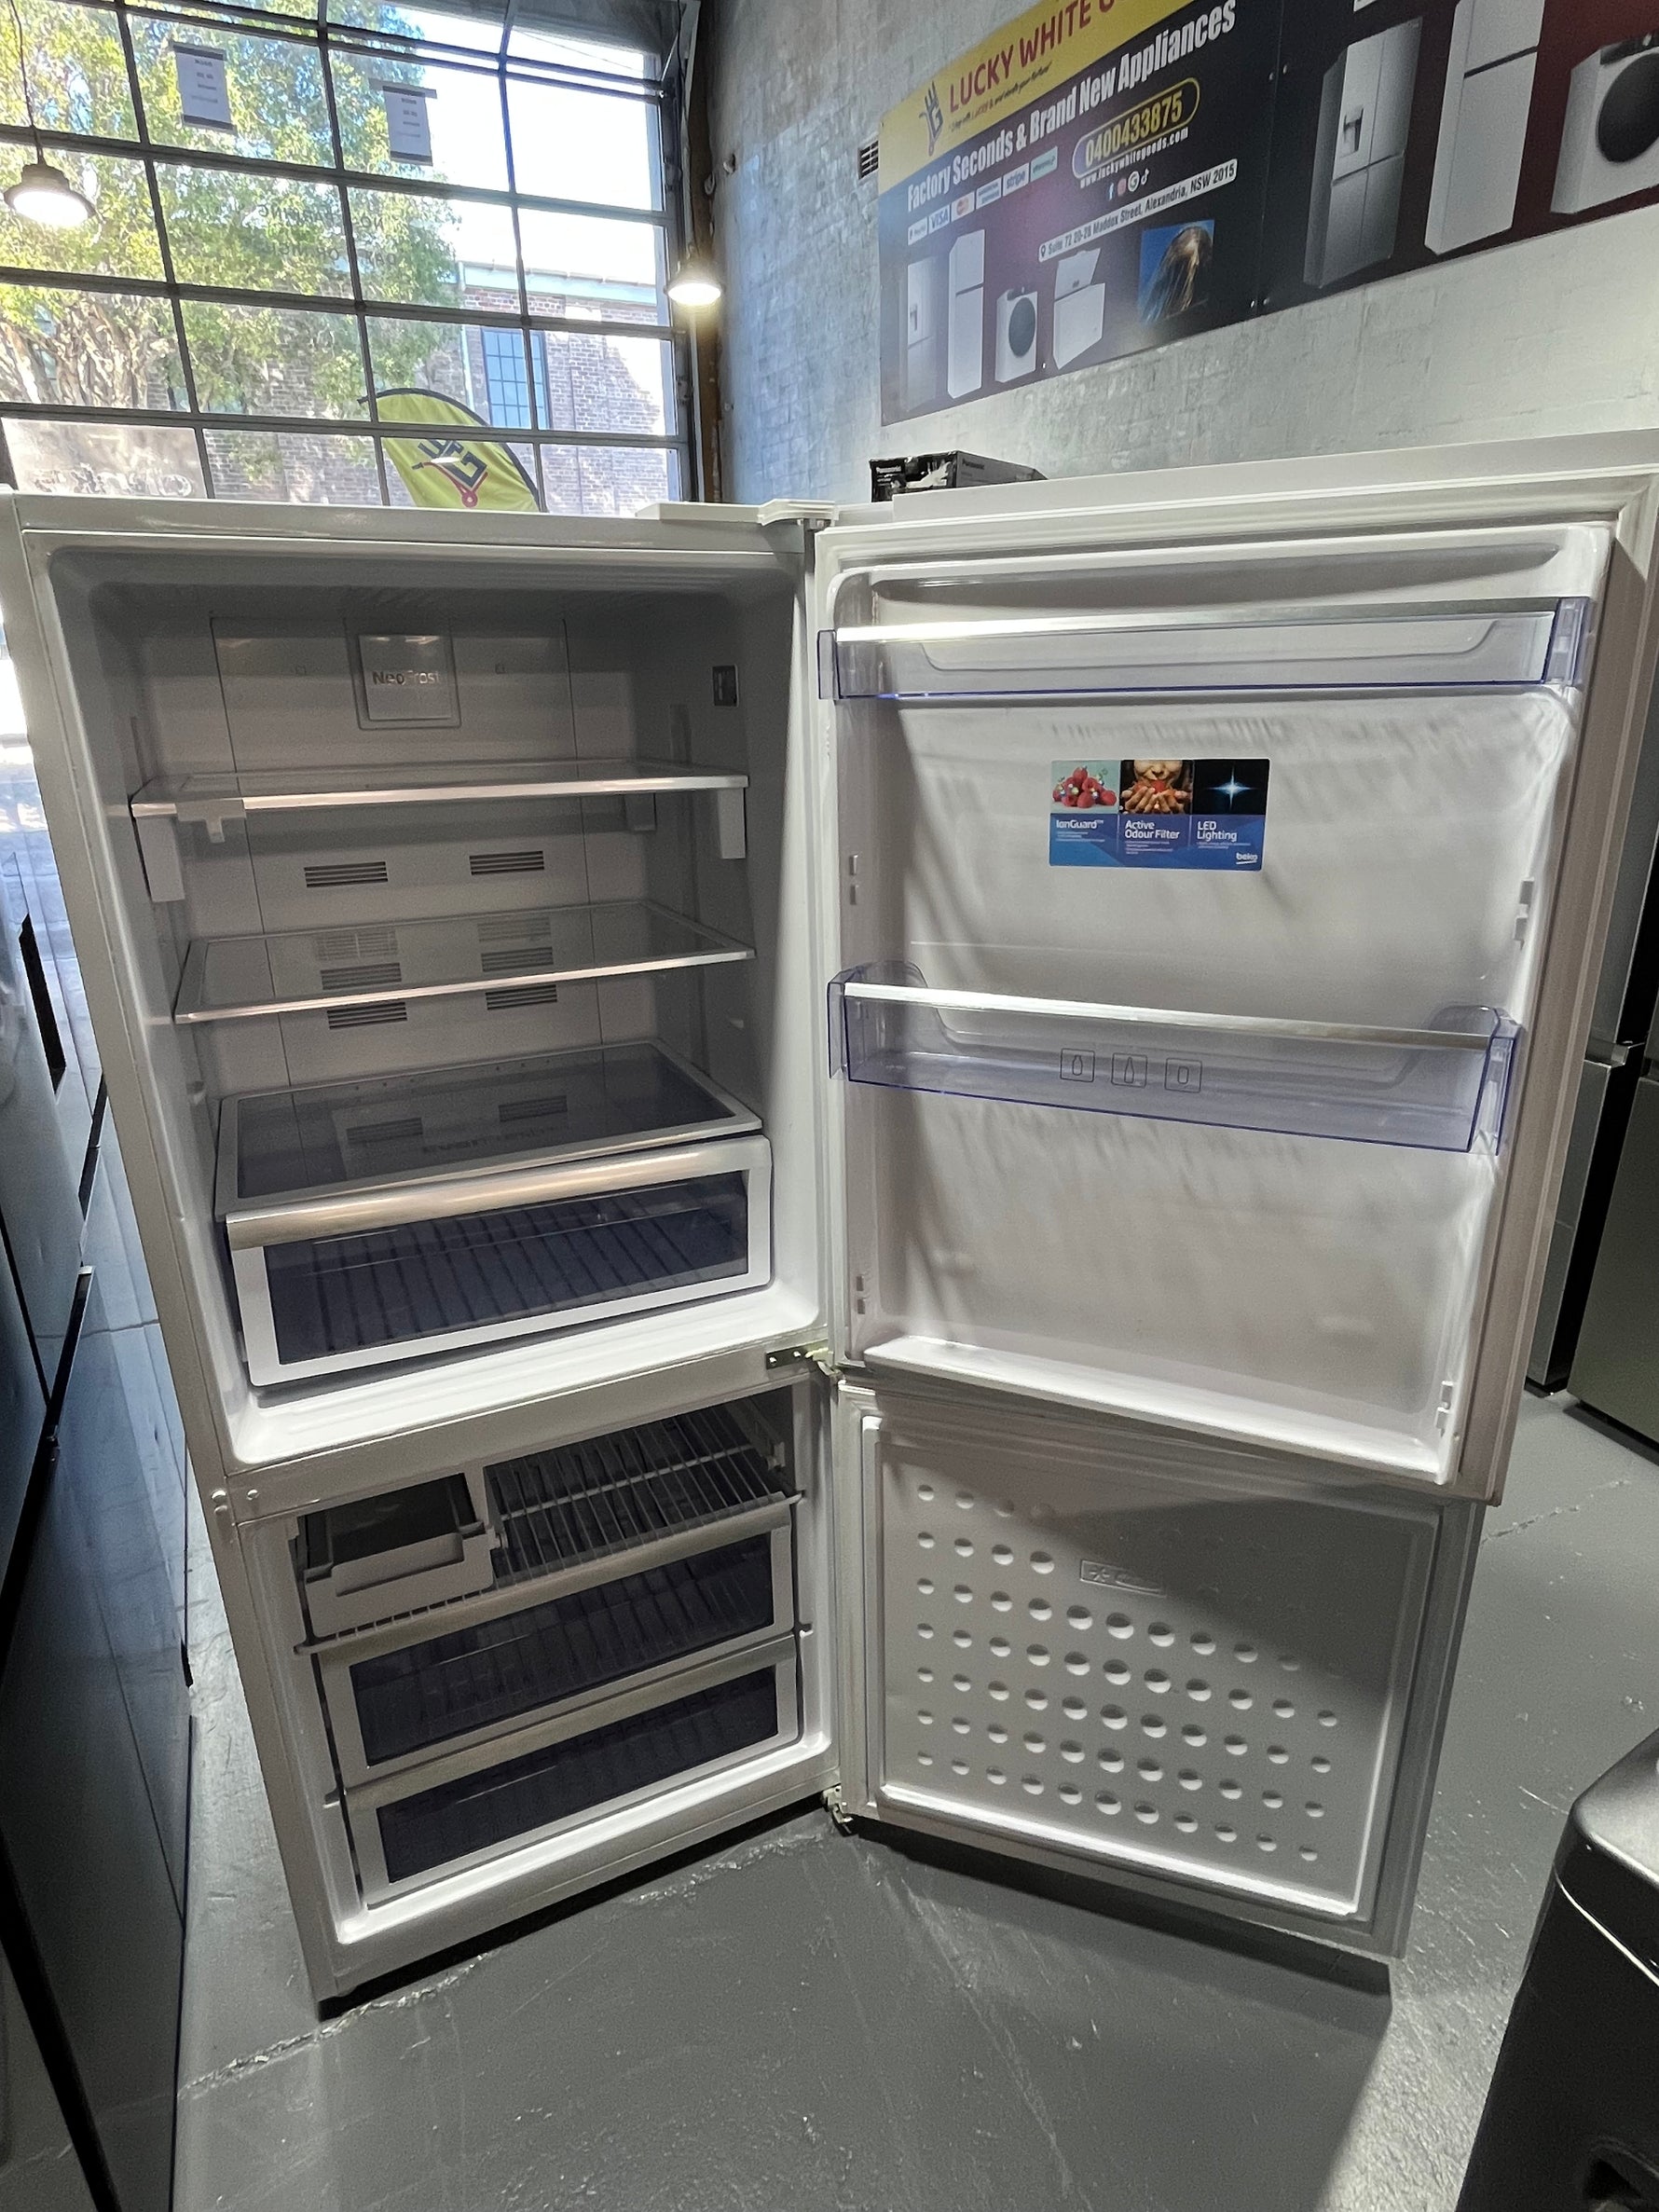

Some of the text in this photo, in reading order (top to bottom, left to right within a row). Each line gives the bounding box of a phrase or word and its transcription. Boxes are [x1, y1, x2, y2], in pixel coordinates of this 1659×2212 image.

[950, 44, 1014, 113] LUCKY
[1019, 0, 1091, 68] WHITE
[908, 165, 952, 213] Factory
[953, 129, 1013, 185] Seconds
[1016, 122, 1027, 150] &
[1030, 86, 1076, 144] Brand
[1079, 67, 1116, 115] New
[1117, 0, 1236, 92] Appliances
[1086, 90, 1183, 168] 0400433875
[1080, 127, 1188, 188] www.luckywhitegoods.com
[931, 207, 949, 227] VISA
[1092, 215, 1118, 237] Maddox
[1190, 172, 1212, 194] NSW
[1213, 162, 1235, 185] 2015
[1125, 820, 1155, 830] Active
[1125, 829, 1180, 840] Odour Filter
[1197, 830, 1238, 843] Lighting
[1198, 820, 1216, 831] LED
